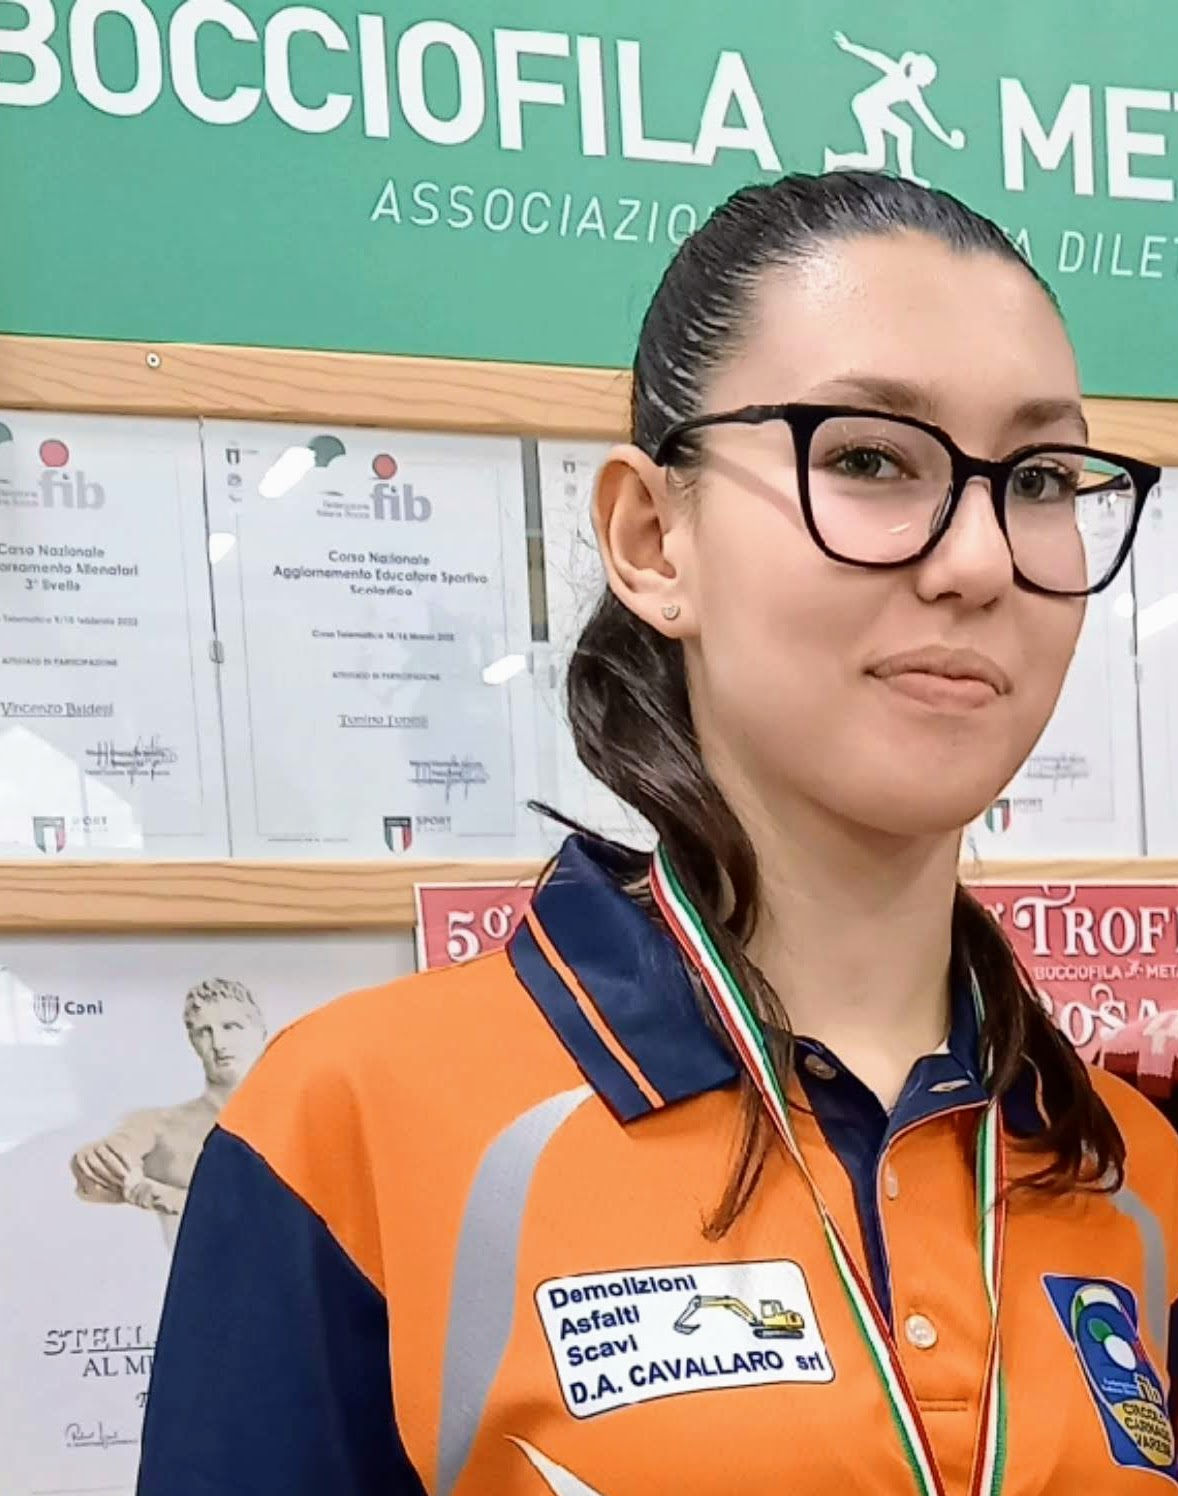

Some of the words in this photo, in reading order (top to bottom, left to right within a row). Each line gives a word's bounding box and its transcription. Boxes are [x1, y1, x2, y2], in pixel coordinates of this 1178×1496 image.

[0, 0, 783, 172] BOCCIOFILA
[371, 179, 715, 246] ASSOCIAZIO
[369, 483, 433, 522] fib
[328, 550, 366, 563] Corso
[369, 551, 430, 566] Nazionale
[64, 999, 104, 1016] Coni
[548, 1274, 698, 1310] Demolizioni
[560, 1305, 640, 1341] Asfalti
[567, 1334, 638, 1367] Scavi
[569, 1373, 623, 1405] D.A.
[629, 1350, 784, 1388] CAVALLARO
